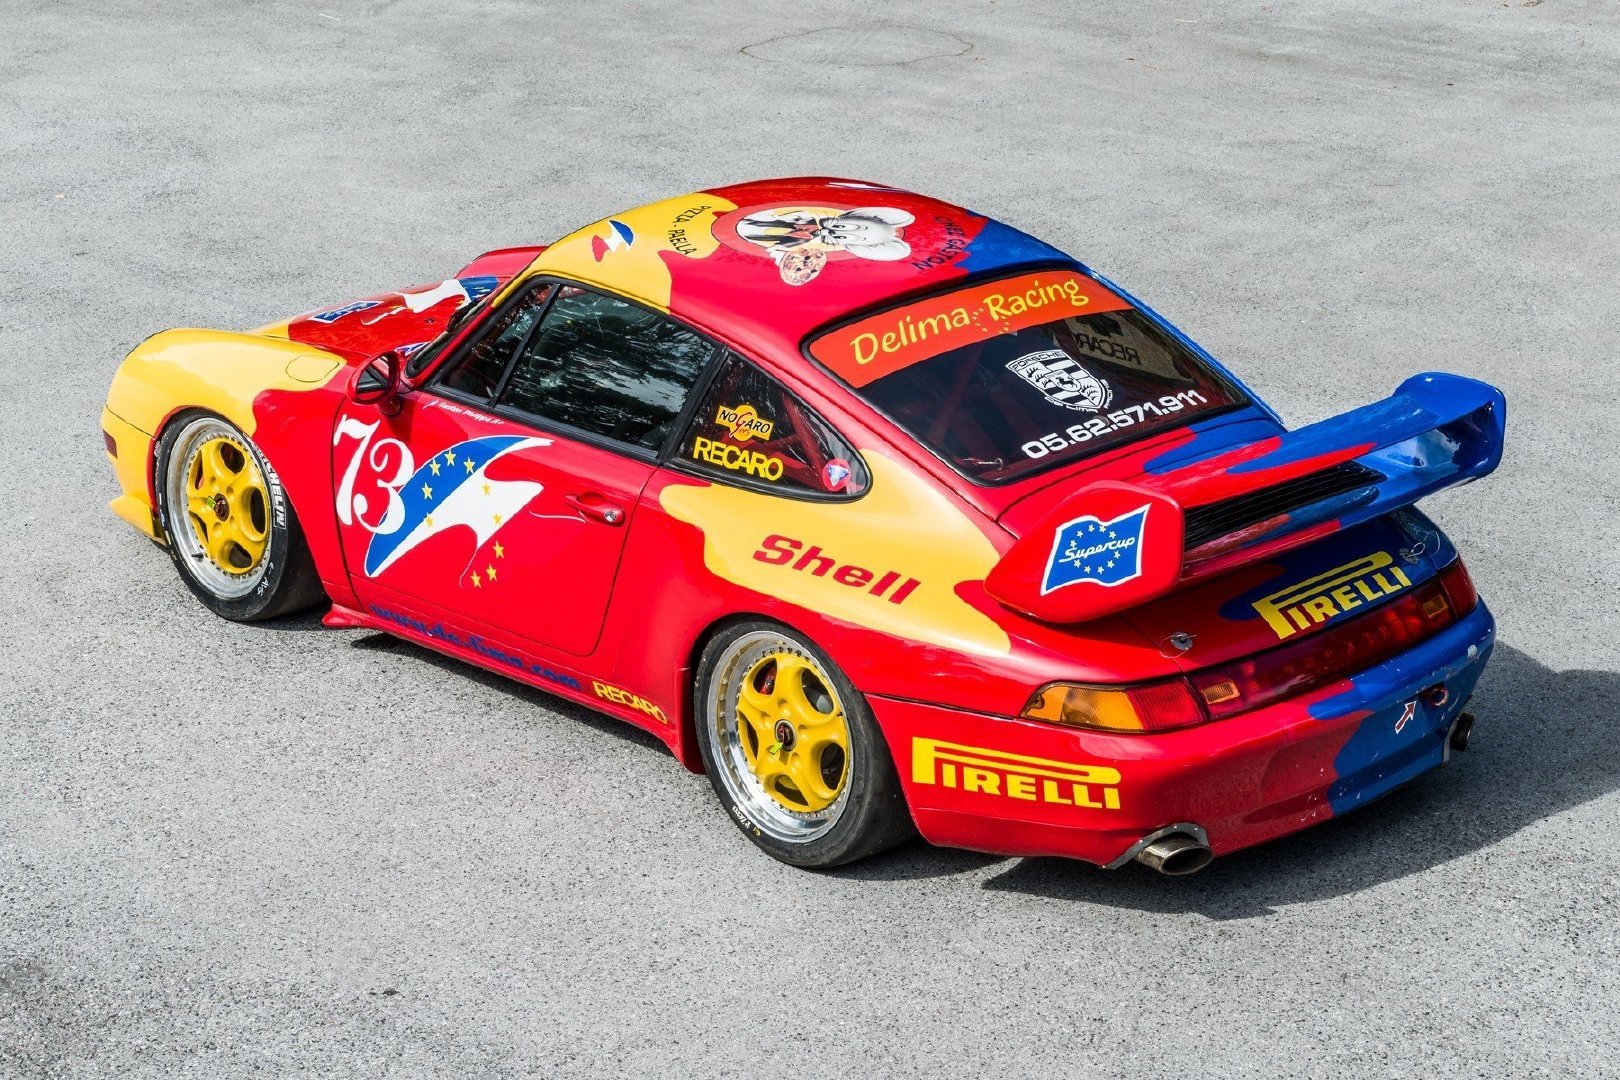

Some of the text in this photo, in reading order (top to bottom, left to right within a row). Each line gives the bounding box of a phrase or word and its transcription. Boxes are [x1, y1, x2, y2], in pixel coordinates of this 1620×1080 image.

[668, 204, 712, 255] PIZZA PAELLA
[911, 238, 965, 271] GASTON
[849, 277, 1089, 366] Delima Racing
[1012, 350, 1063, 370] PORSCHE
[719, 409, 770, 438] NOGARO
[1021, 389, 1208, 460] 05.62.571.911
[333, 413, 415, 535] 73
[692, 436, 784, 481] RECARO
[752, 534, 922, 605] Shell
[1058, 535, 1136, 563] Supercup
[1250, 550, 1412, 640] PIRELLI
[592, 680, 668, 725] RECARO
[911, 736, 1122, 810] PIRELLI
